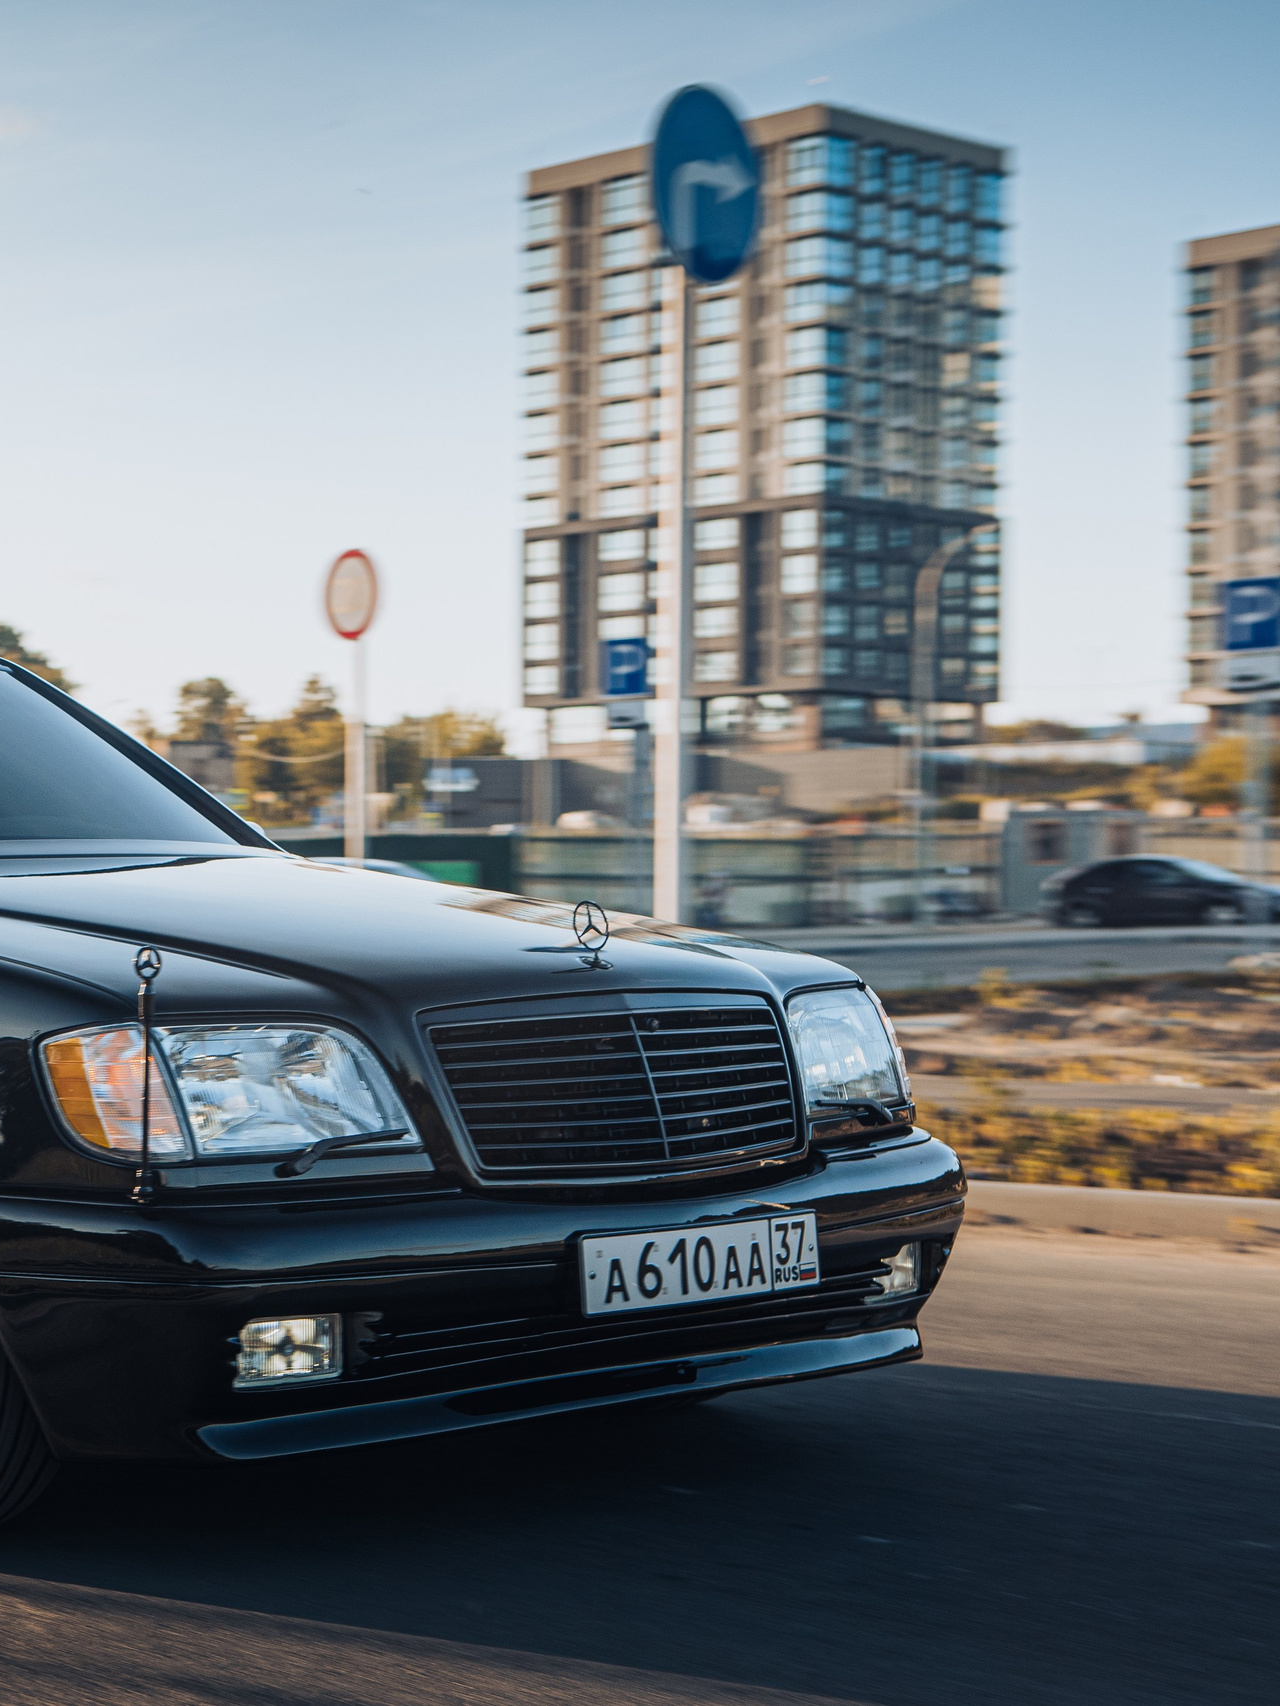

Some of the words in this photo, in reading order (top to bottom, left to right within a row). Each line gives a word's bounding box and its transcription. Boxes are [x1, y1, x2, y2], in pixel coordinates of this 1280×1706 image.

[1226, 586, 1280, 642] P
[608, 644, 647, 689] P
[774, 1218, 806, 1266] 37
[774, 1265, 800, 1284] RUS
